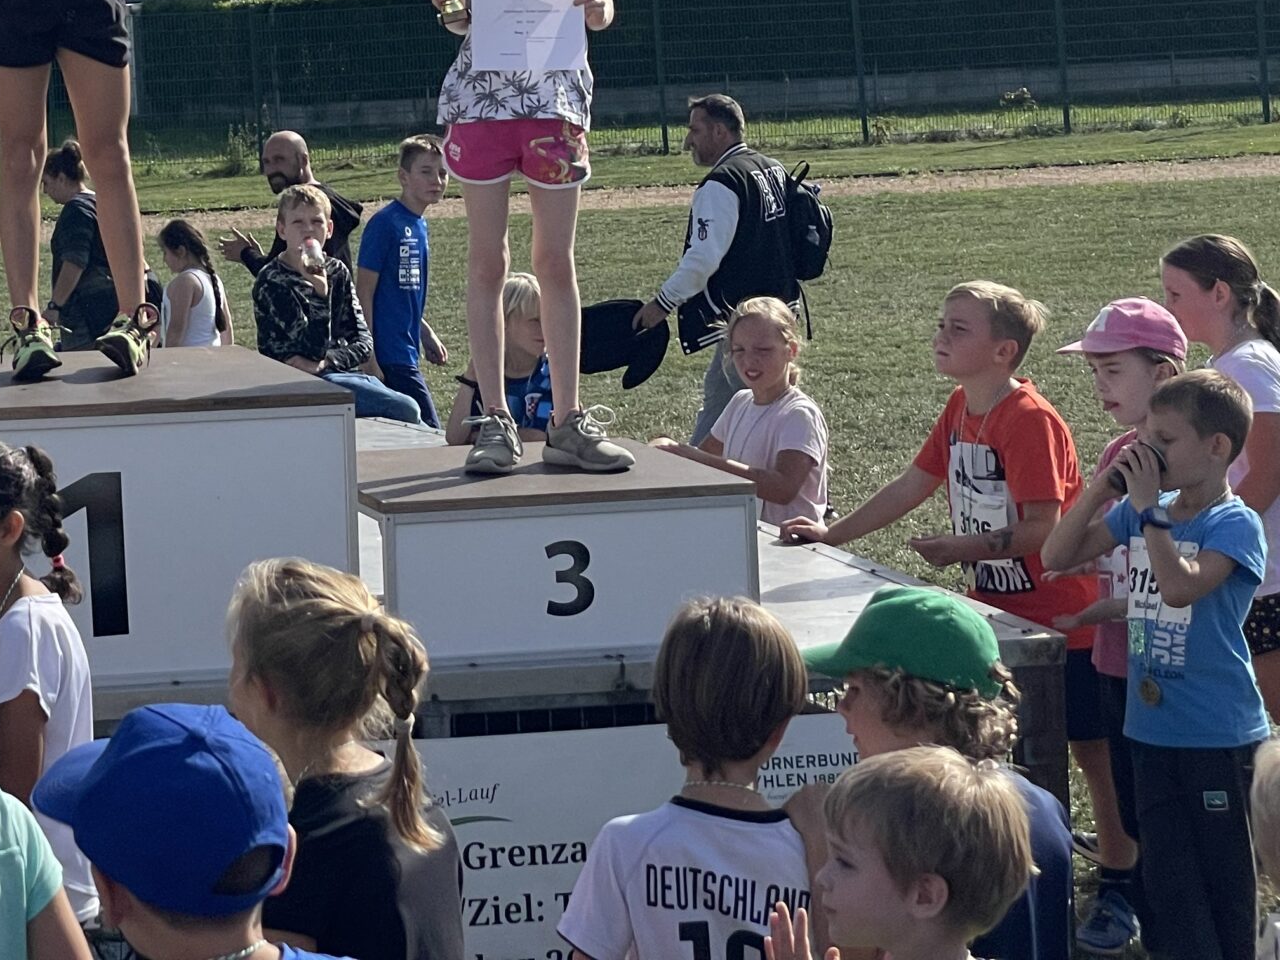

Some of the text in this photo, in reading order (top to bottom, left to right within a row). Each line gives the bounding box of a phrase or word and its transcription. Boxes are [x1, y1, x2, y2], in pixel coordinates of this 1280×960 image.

[56, 471, 130, 637] 1
[960, 511, 992, 534] 3136
[544, 540, 595, 617] 3
